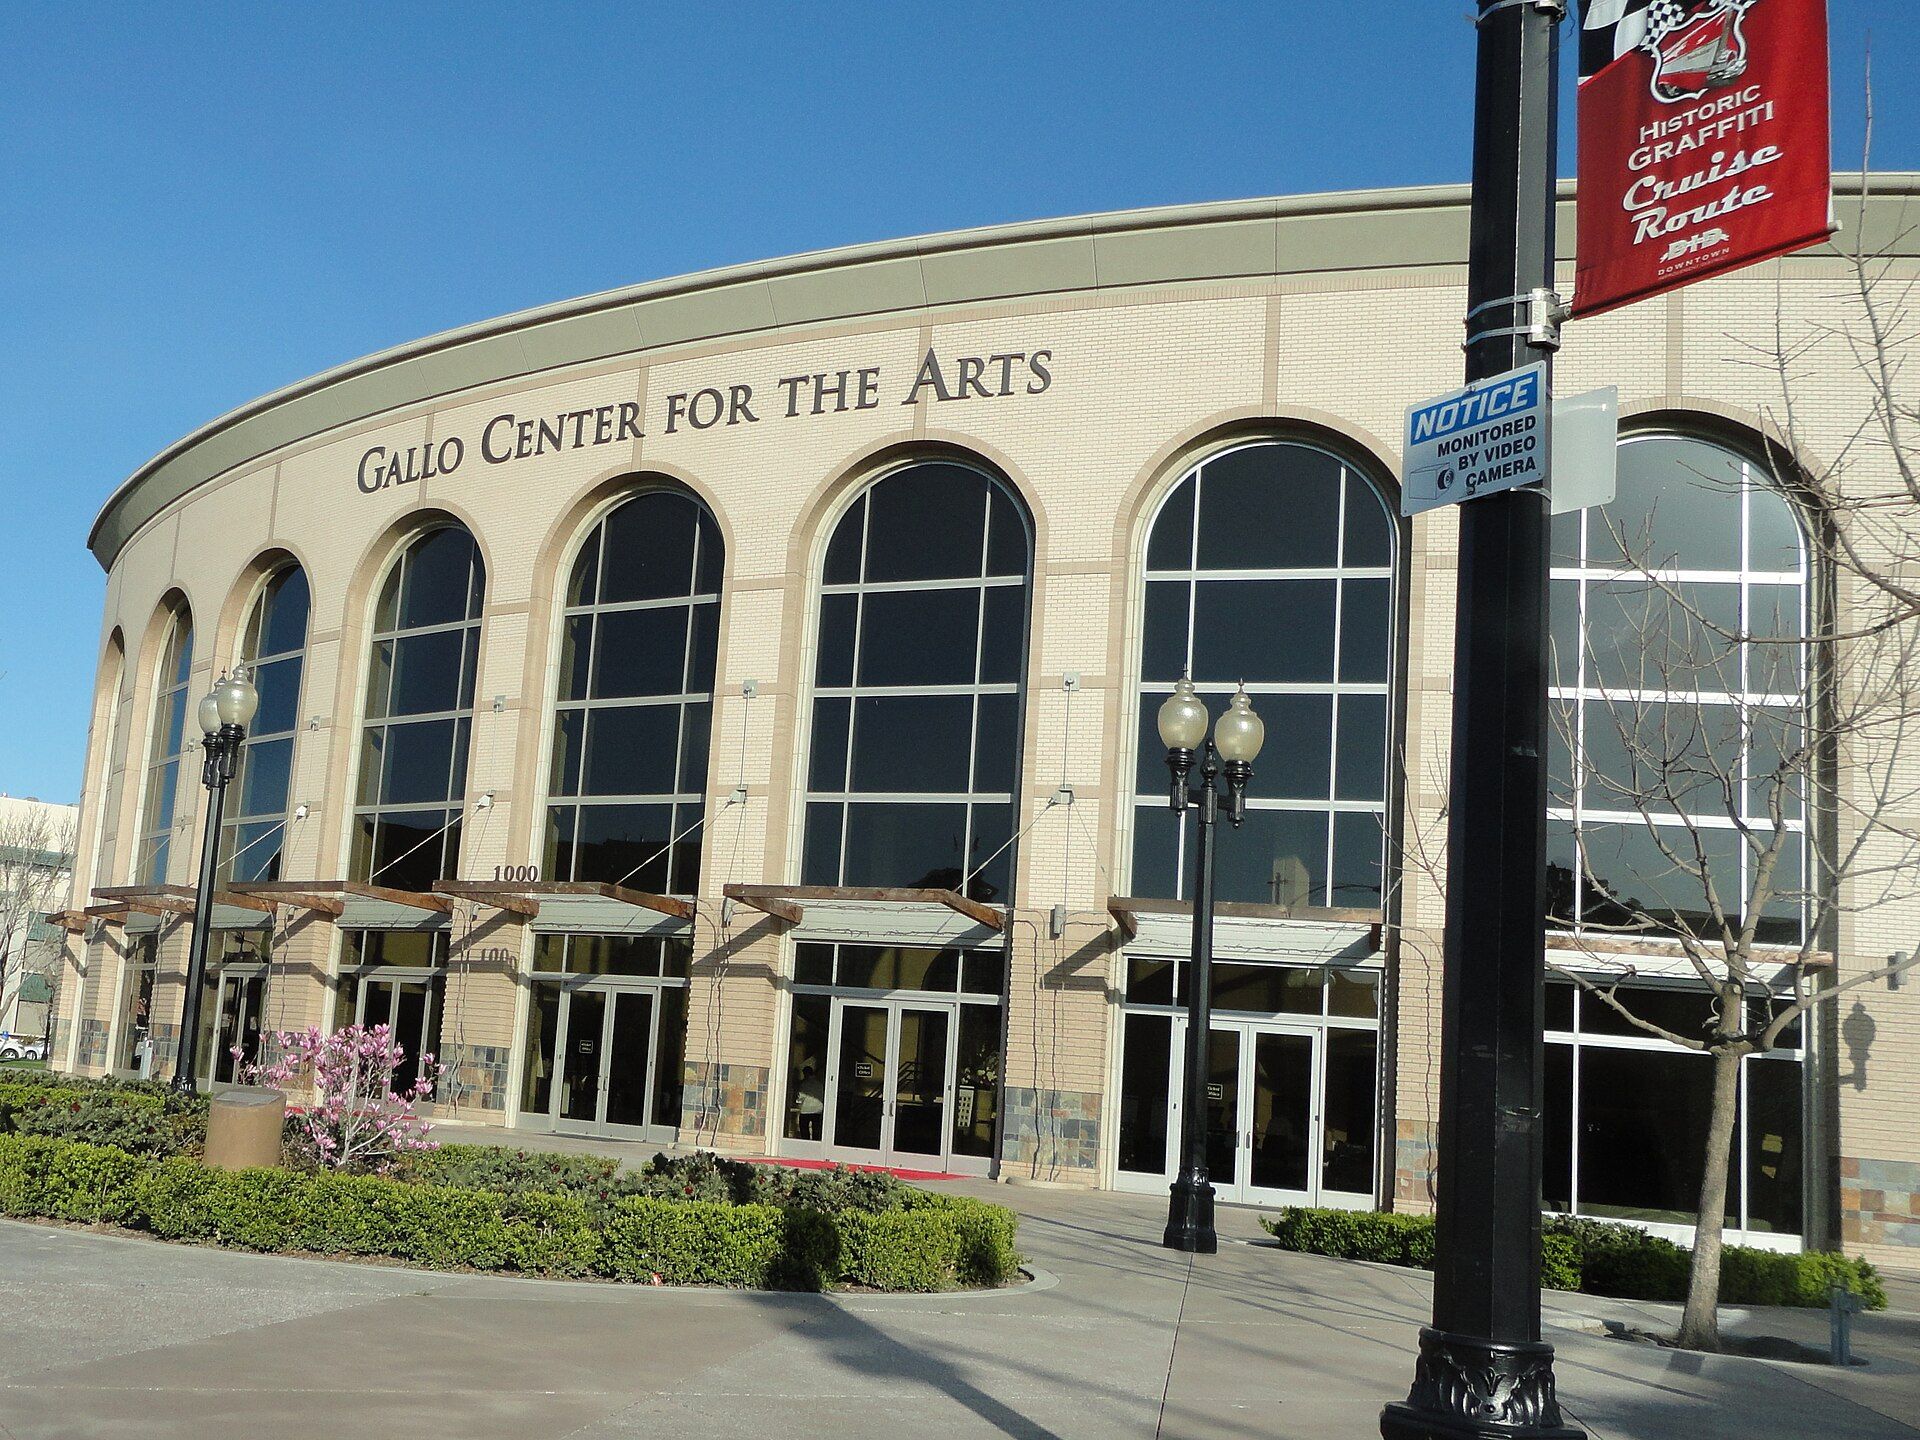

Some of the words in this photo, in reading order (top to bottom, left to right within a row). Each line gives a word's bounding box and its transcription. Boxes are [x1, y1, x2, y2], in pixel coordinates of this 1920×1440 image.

[1627, 100, 1775, 171] GRAFFITI
[1639, 84, 1761, 145] HISTORIC
[1622, 145, 1783, 211] Cruise
[1630, 182, 1774, 245] Route
[1658, 247, 1730, 276] DOWNTOWN
[357, 437, 465, 494] GALLO
[481, 401, 646, 465] CENTER
[664, 383, 760, 434] FOR
[777, 366, 881, 418] THE
[900, 346, 1053, 406] ARTS
[1414, 376, 1534, 441] NOTICE
[1437, 415, 1537, 458] MONITORED
[1458, 451, 1480, 471] BY
[1484, 435, 1537, 463] VIDEO
[1465, 456, 1537, 488] CAMERA
[493, 865, 539, 882] 1000
